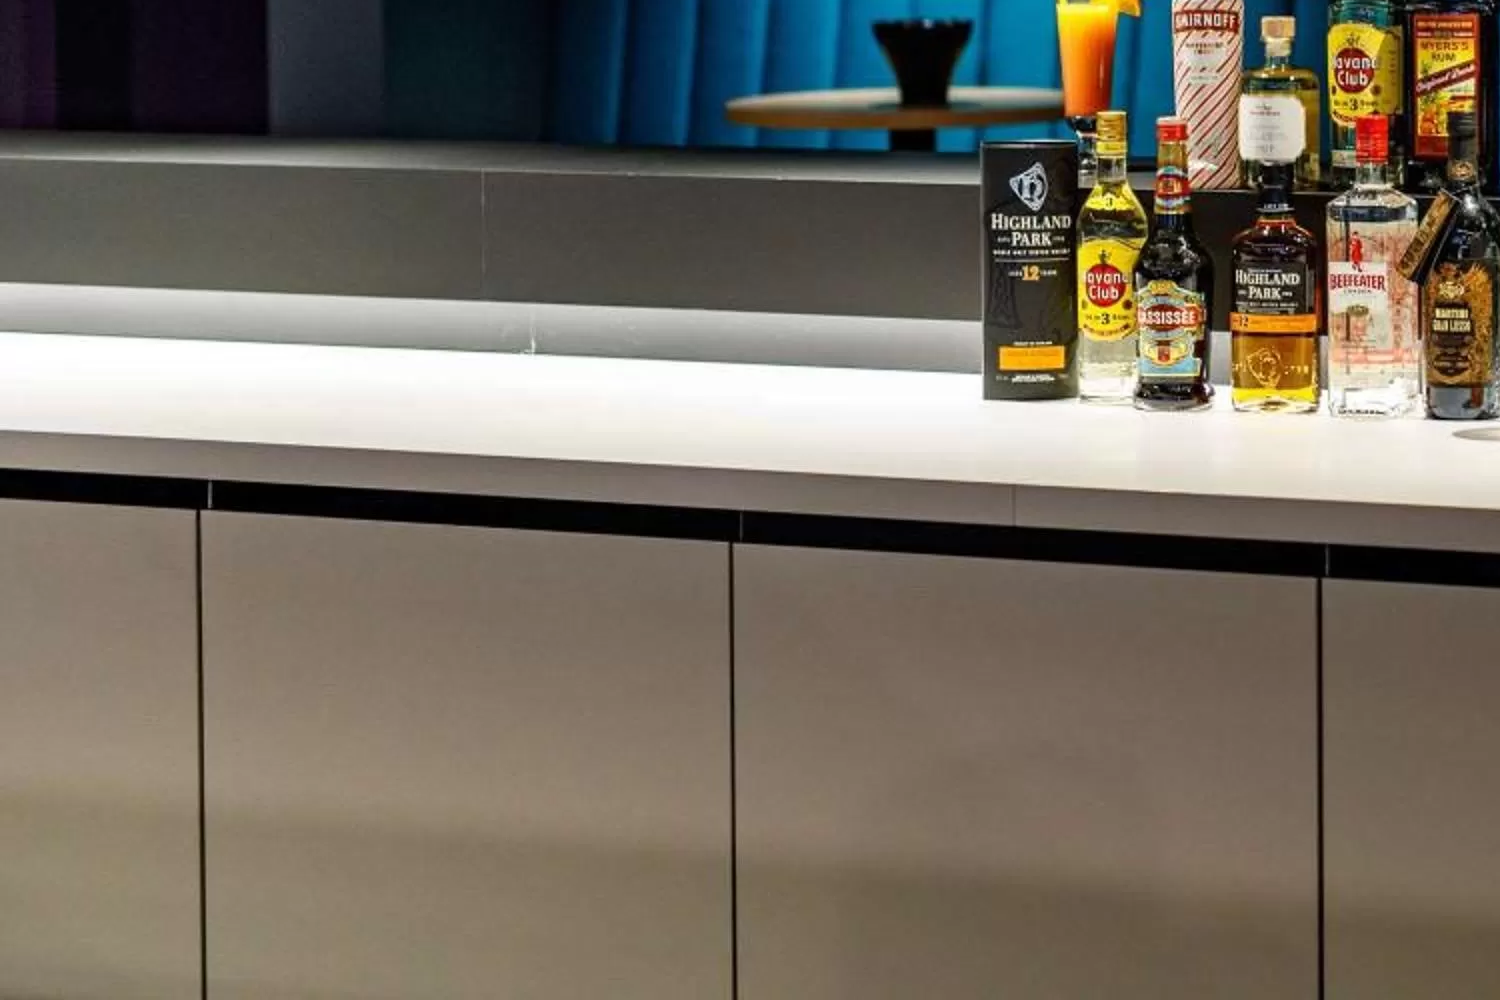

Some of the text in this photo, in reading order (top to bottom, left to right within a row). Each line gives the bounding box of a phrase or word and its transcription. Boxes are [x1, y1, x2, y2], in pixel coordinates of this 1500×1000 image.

[1175, 12, 1236, 29] SMIRNOFF
[1338, 70, 1369, 86] Club
[1022, 265, 1040, 281] 12
[1329, 273, 1386, 291] BEEFEATER
[1088, 286, 1120, 301] Club
[1101, 313, 1110, 325] 3
